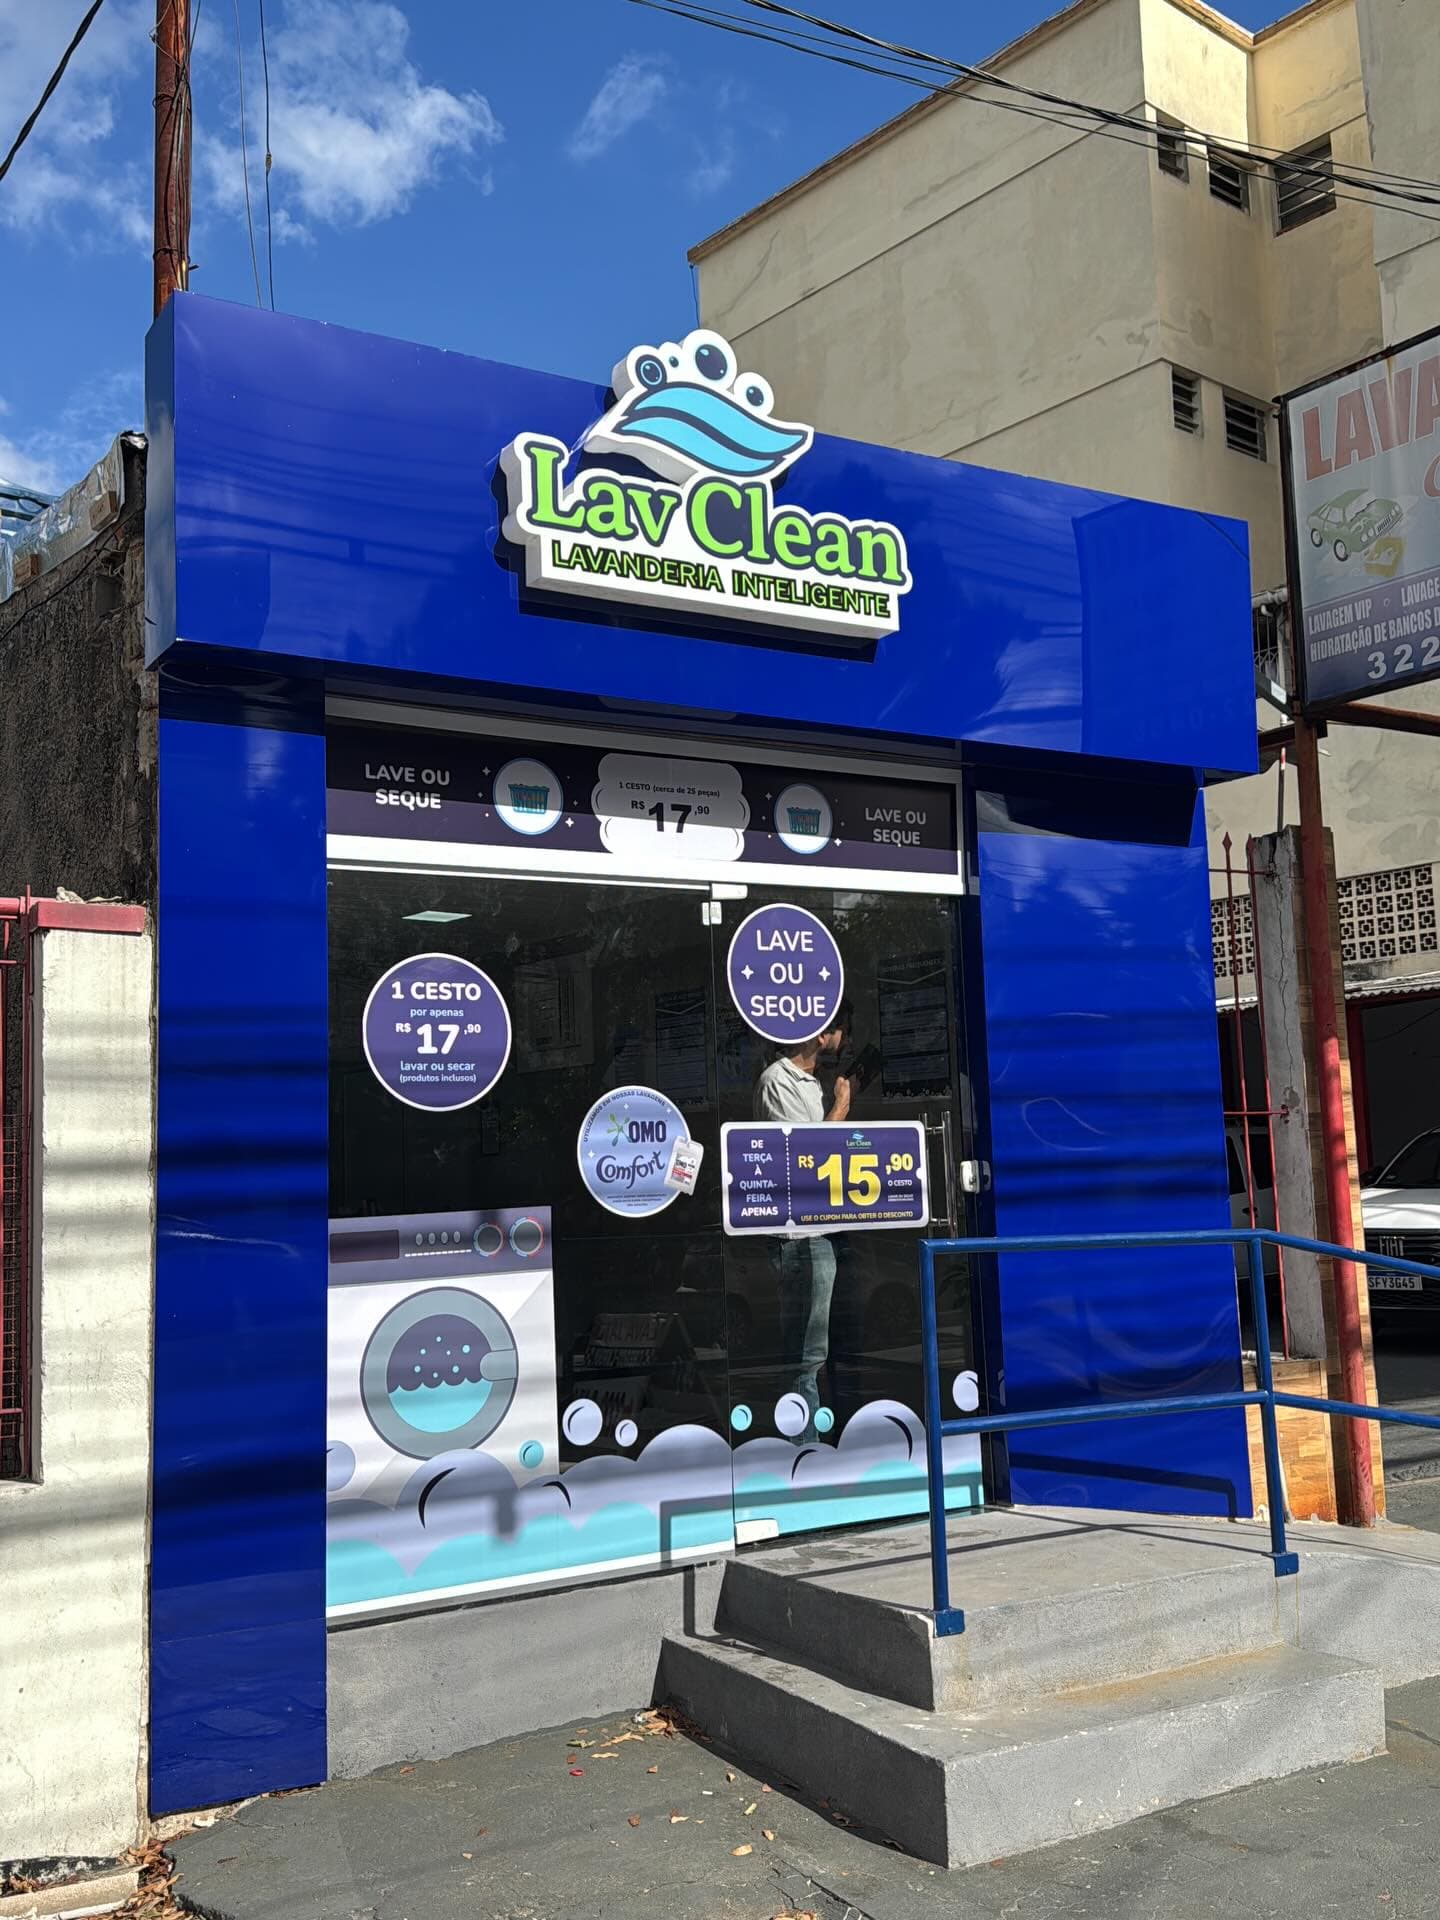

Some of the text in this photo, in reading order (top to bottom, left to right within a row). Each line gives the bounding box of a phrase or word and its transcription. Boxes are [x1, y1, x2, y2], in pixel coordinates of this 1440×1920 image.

[552, 541, 892, 619] LAVANDERIA INTELIGENTE
[1308, 603, 1354, 636] LAVAGEM
[1354, 598, 1373, 620] VIP
[1310, 625, 1372, 663] HIDRATAÇÃO
[1373, 621, 1389, 644] DE
[1388, 608, 1432, 640] BANCOS
[365, 763, 450, 786] LAVE OU
[625, 782, 651, 791] CESTO
[653, 783, 675, 793] (cerca
[676, 786, 686, 794] de
[687, 787, 697, 795] 25
[697, 788, 720, 798] peças)
[375, 788, 441, 811] SEQUE
[865, 807, 927, 825] LAVE OU
[873, 828, 921, 847] SEQUE
[756, 929, 814, 952] LAVE
[769, 962, 803, 984] OU
[391, 981, 482, 1001] 1 CESTO
[410, 1008, 464, 1018] por apenas
[750, 995, 826, 1022] SEQUE
[396, 1023, 411, 1033] R$
[400, 1060, 476, 1071] lavar ou secar
[400, 1074, 477, 1083] (produtos inclusos)
[628, 1120, 667, 1143] OMO
[751, 1140, 764, 1149] DE
[742, 1153, 773, 1163] TERÇA
[798, 1155, 815, 1169] R$
[596, 1150, 666, 1189] Comfort
[739, 1179, 777, 1190] QUINTA-
[894, 1179, 913, 1187] CESTO
[746, 1194, 772, 1203] FEIRA
[741, 1206, 779, 1217] APENAS
[801, 1214, 813, 1222] USE
[819, 1213, 841, 1221] CUPOM
[841, 1212, 857, 1220] PARA
[858, 1212, 877, 1220] OBTER
[883, 1210, 914, 1219] DESCONTO
[1380, 1236, 1405, 1256] FIAT
